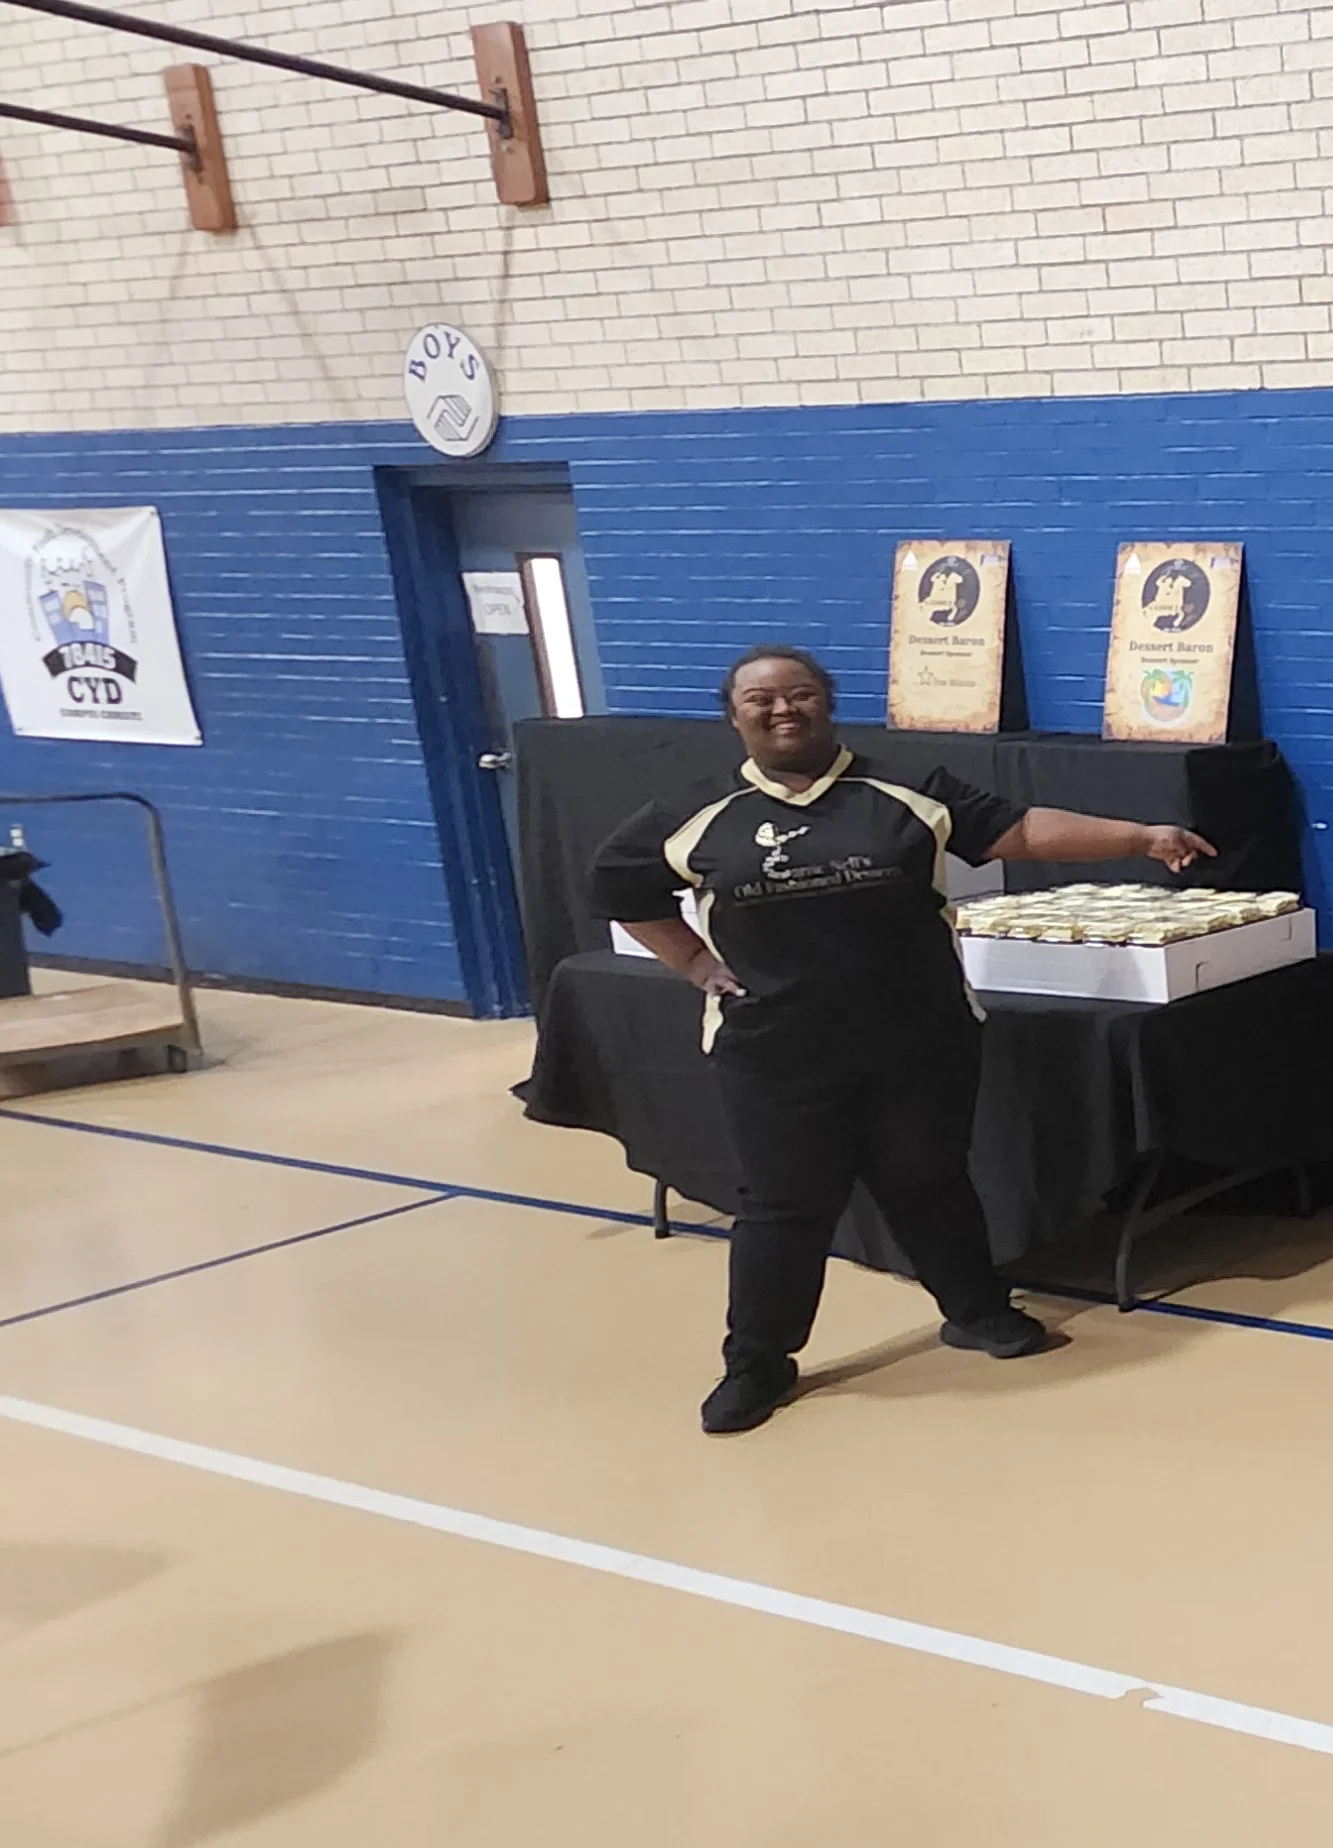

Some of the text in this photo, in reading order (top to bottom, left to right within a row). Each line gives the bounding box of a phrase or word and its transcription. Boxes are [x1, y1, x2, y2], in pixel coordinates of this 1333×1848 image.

[408, 330, 480, 384] BOYS
[908, 634, 985, 647] Dessert Baron
[1128, 640, 1214, 653] Dessert Baron
[66, 675, 123, 705] CYD
